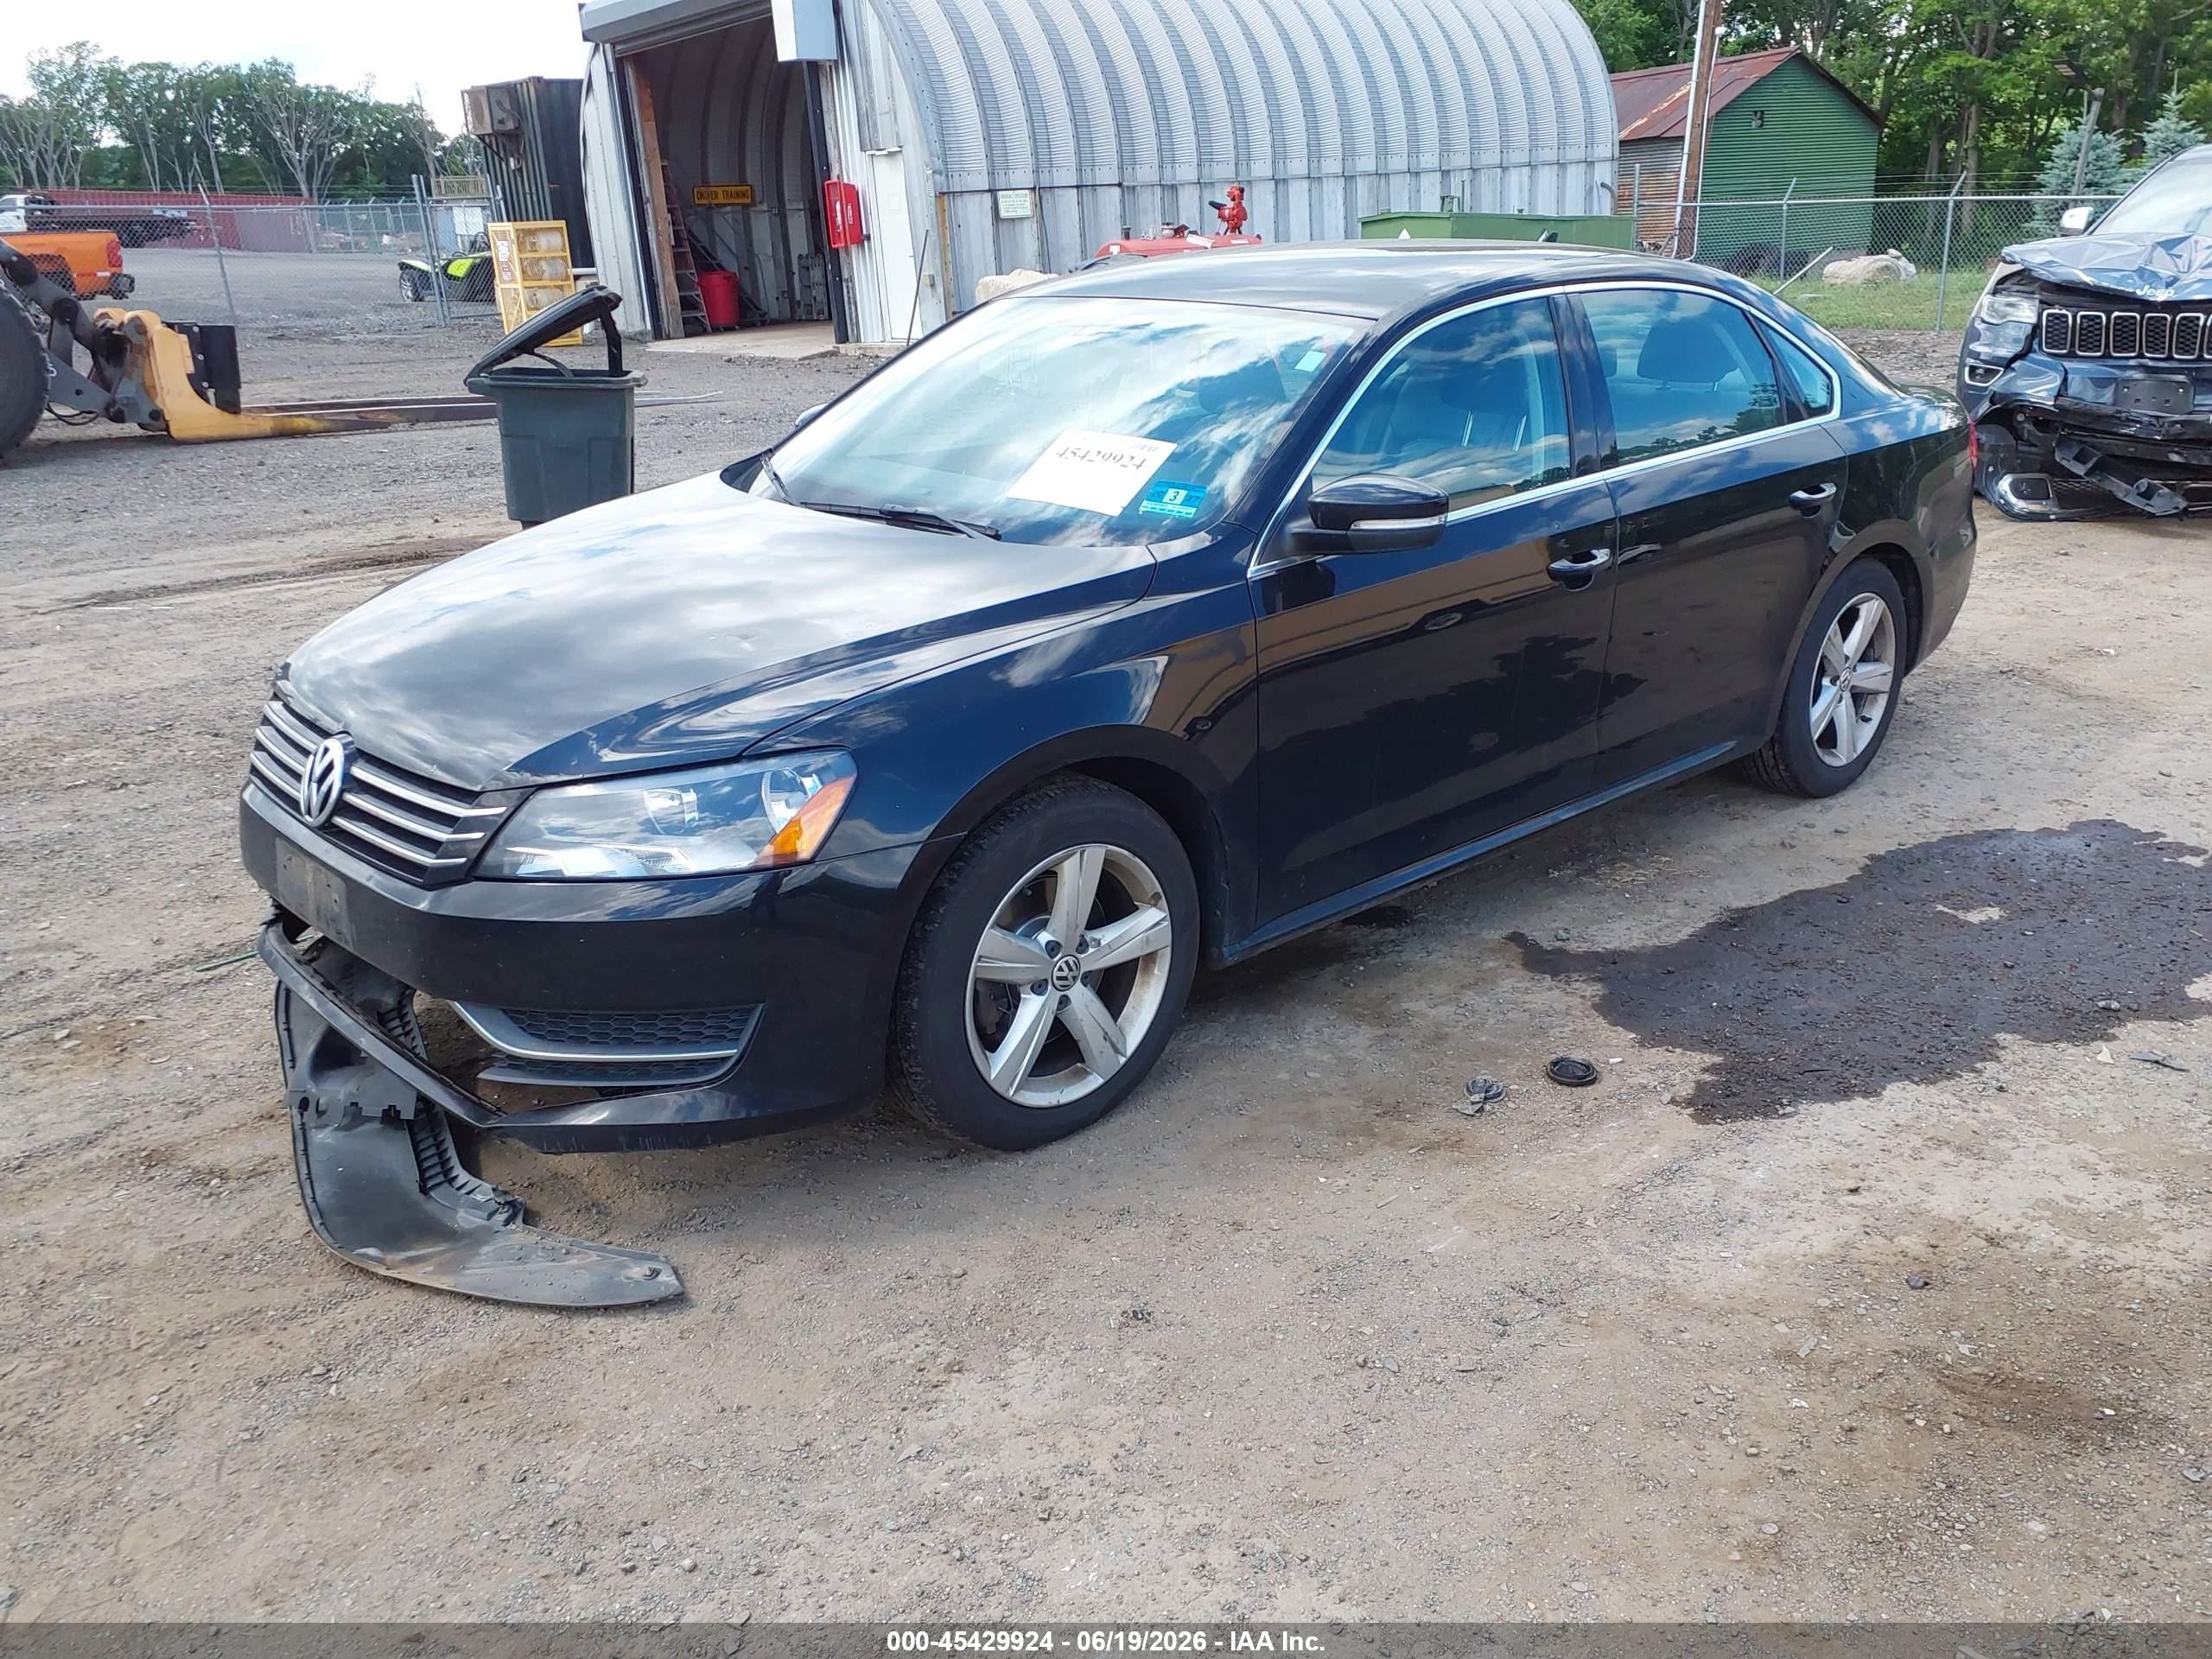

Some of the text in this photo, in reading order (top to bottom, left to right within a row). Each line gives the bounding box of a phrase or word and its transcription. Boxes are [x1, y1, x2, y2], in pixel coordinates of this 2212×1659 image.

[696, 188, 750, 201] DRIVER TRAINING
[2135, 284, 2176, 302] Jeep
[1168, 490, 1180, 502] 3
